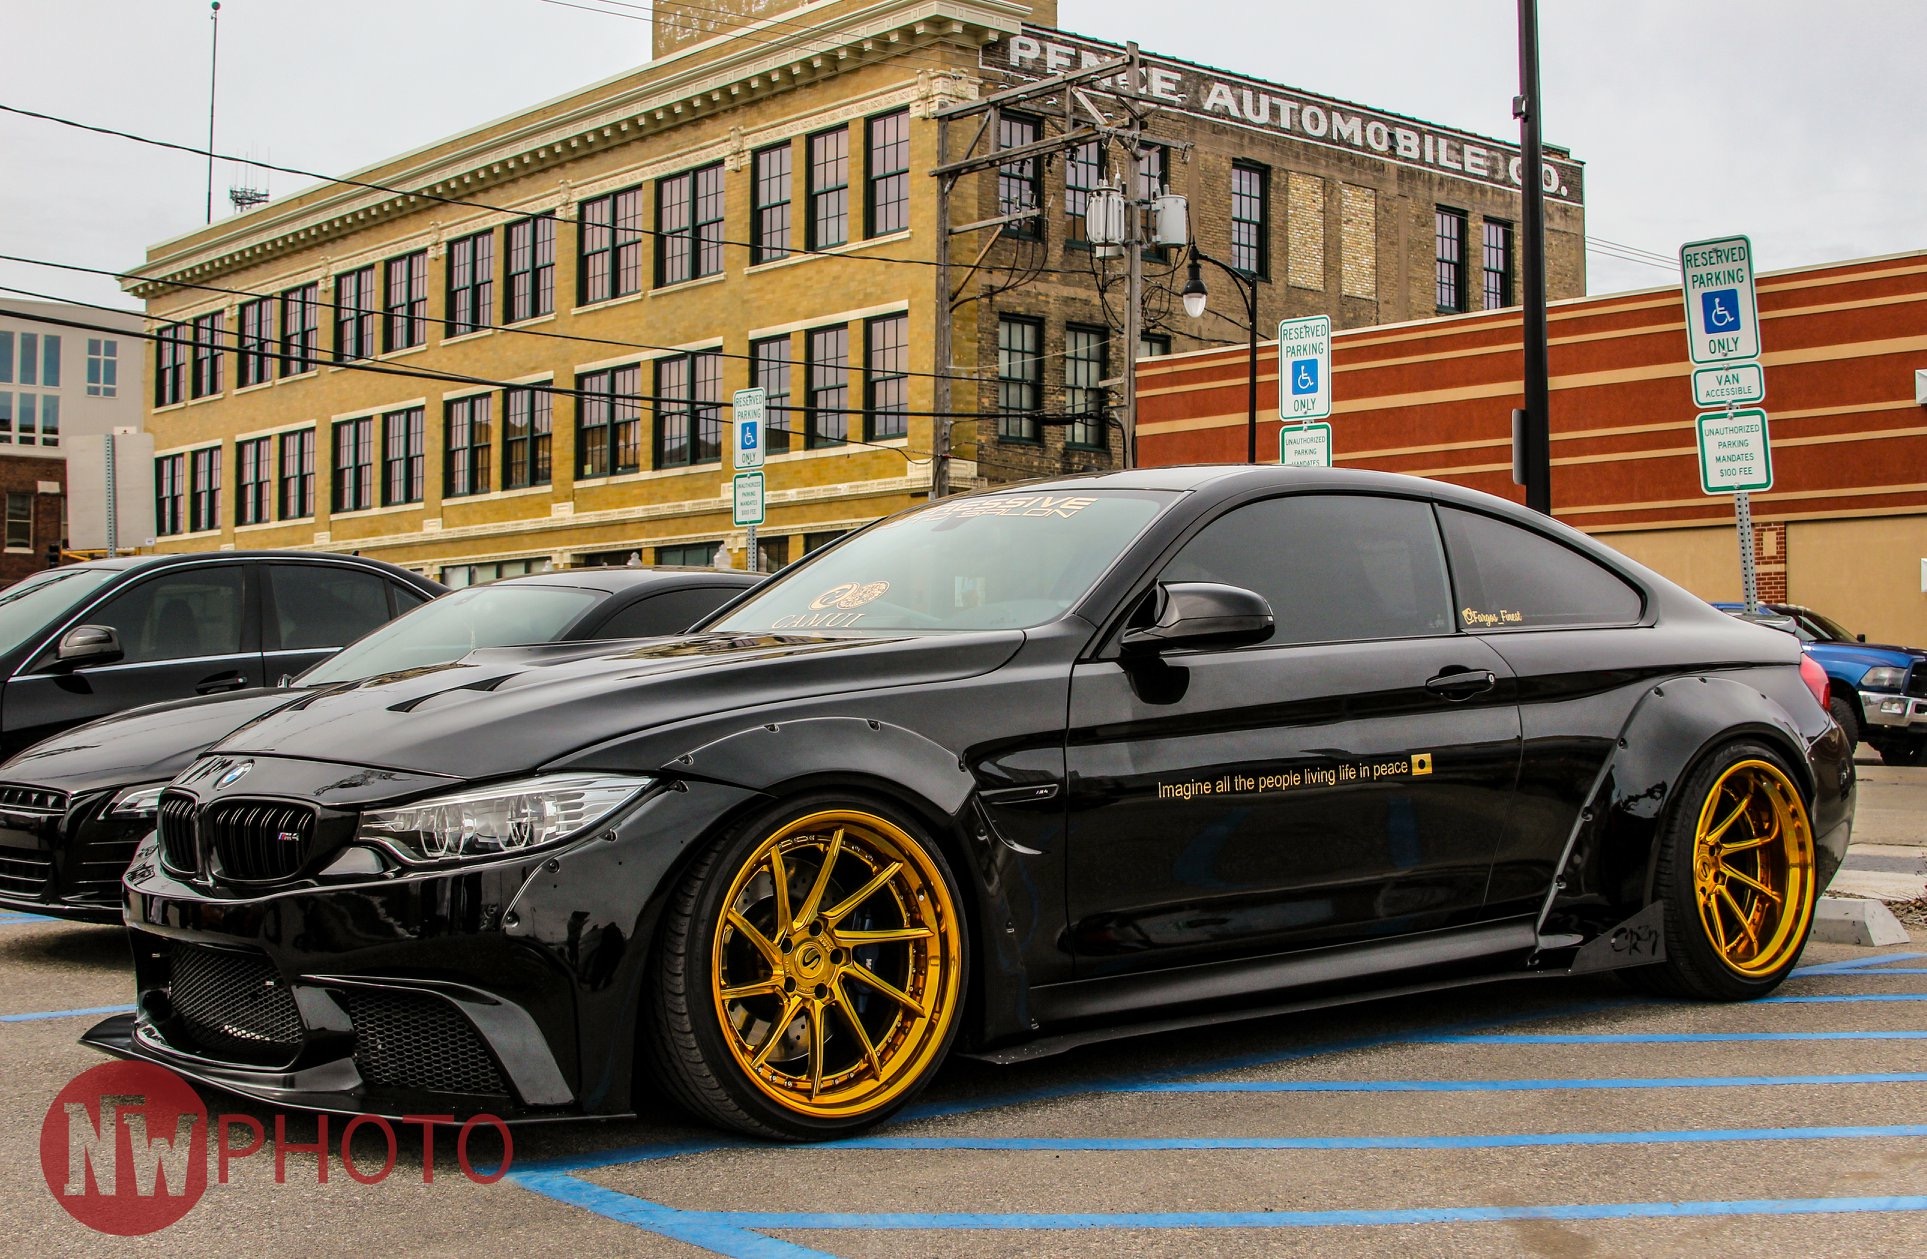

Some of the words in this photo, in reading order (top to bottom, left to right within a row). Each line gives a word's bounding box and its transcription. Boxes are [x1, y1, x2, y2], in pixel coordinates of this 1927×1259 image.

[1203, 82, 1488, 177] AUTOMOBILE
[1685, 247, 1746, 269] RESERVED
[1691, 268, 1744, 289] PARKING
[1283, 324, 1327, 341] RESERVED
[1286, 342, 1324, 358] PARKING
[1708, 337, 1739, 354] ONLY
[1716, 373, 1740, 386] VAN
[1705, 386, 1752, 398] ACCESSIBLE
[736, 395, 763, 407] RESERVED
[1293, 398, 1316, 412] ONLY
[738, 409, 761, 420] PARKING
[1704, 424, 1760, 436] UNAUTHORIZED
[1286, 436, 1326, 446] UNAUTHORIZED
[1718, 439, 1749, 449] PARKING
[742, 452, 756, 464] ONLY
[1294, 448, 1317, 456] PARKING
[1715, 453, 1755, 463] MANDATES
[1720, 468, 1736, 477] $100
[1739, 467, 1753, 475] FEE
[1158, 779, 1212, 800] Imagine
[1215, 775, 1230, 793] all
[1234, 774, 1255, 791] the
[1258, 770, 1301, 793] people
[1304, 767, 1336, 786] living
[1338, 764, 1357, 781] life
[1359, 763, 1370, 778] in
[1373, 760, 1408, 780] peace
